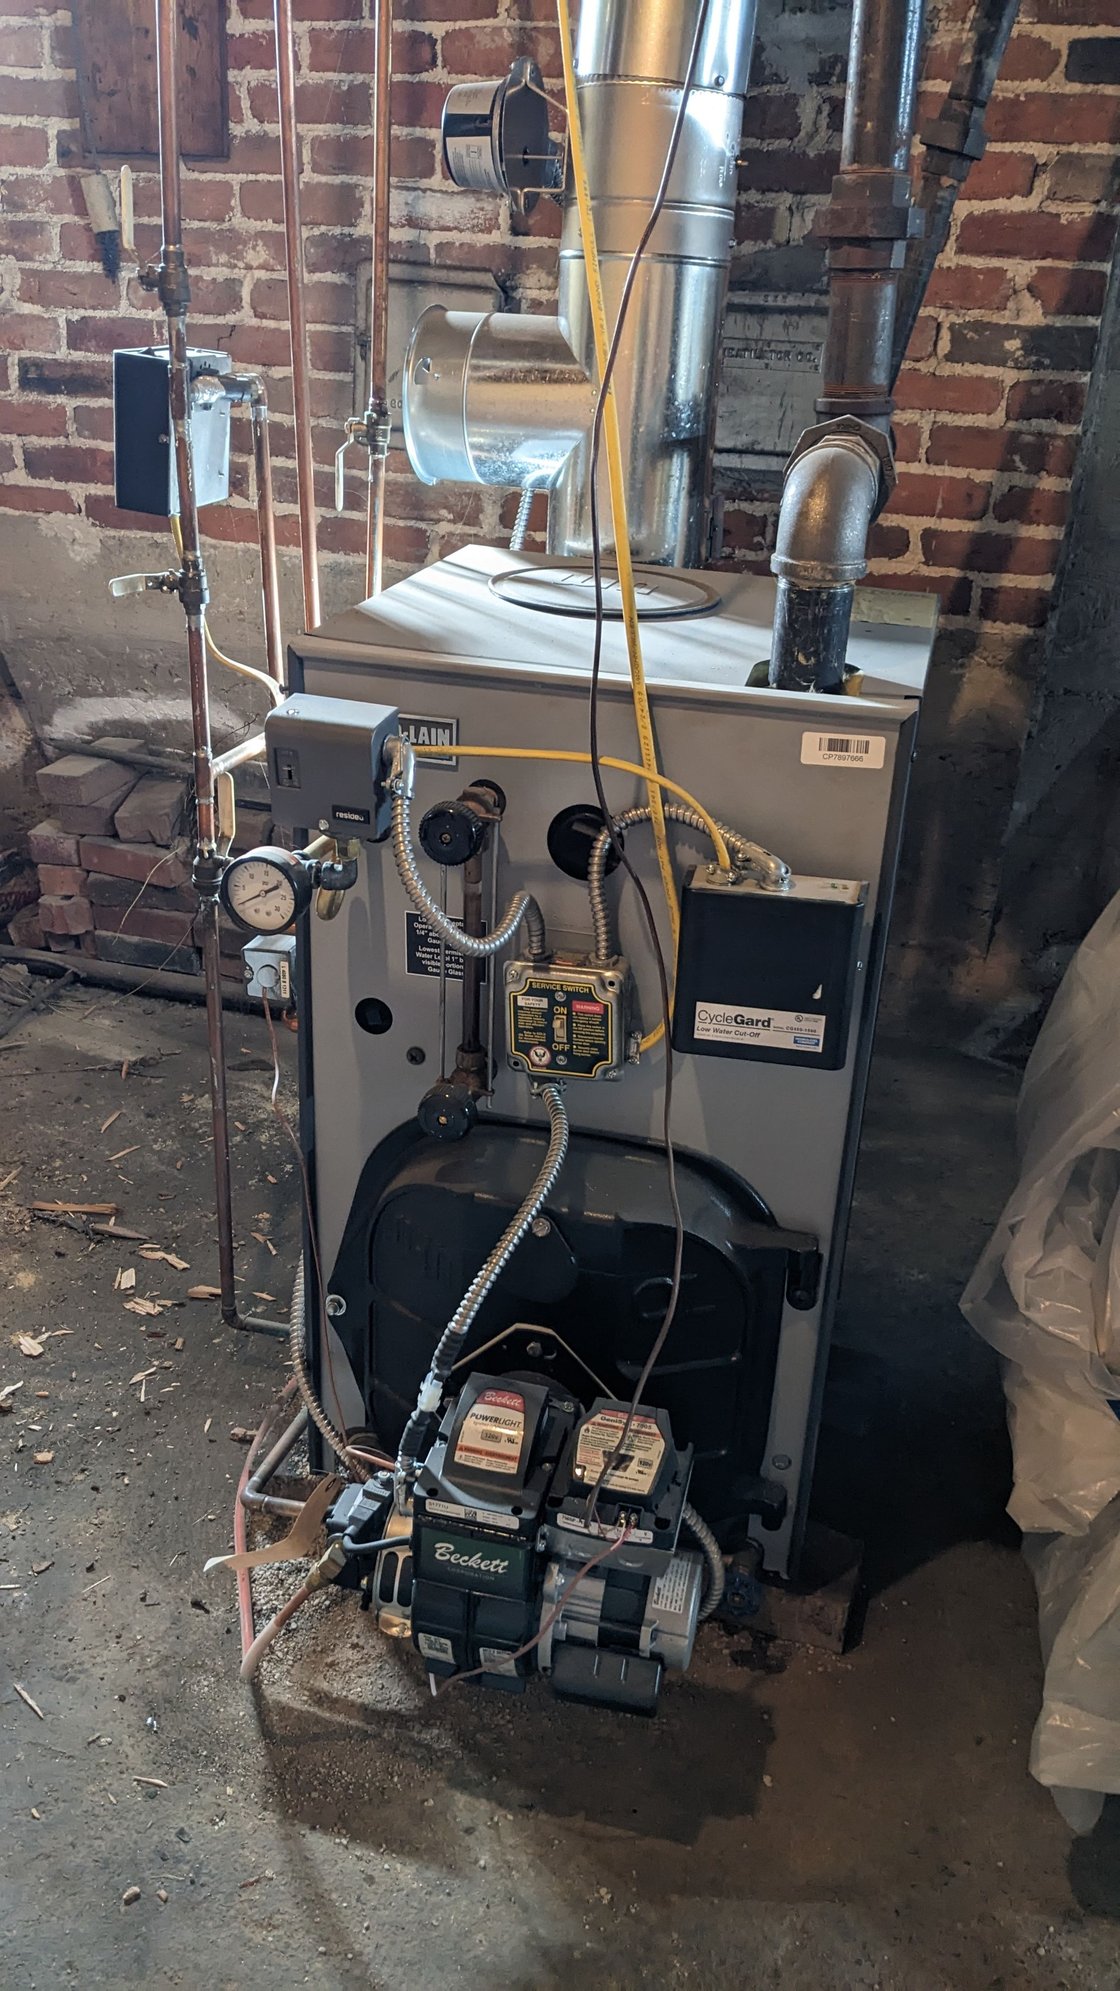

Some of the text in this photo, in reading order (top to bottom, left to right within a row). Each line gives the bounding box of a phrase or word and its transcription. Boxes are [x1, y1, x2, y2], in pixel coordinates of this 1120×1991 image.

[822, 753, 864, 762] CP7897666
[413, 922, 432, 930] Opera
[418, 945, 440, 953] Lowest
[415, 951, 433, 959] Water
[421, 959, 463, 970] visible ortion
[531, 982, 590, 994] SERVICE SWITCH
[553, 1006, 567, 1014] ON
[698, 1009, 771, 1028] CycleGard
[712, 1027, 733, 1035] Water
[734, 1030, 761, 1038] Cut-Off
[552, 1043, 570, 1051] OFF
[484, 1391, 521, 1407] Beckett
[600, 1415, 626, 1425] GeniSy
[434, 1542, 509, 1573] Beckett
